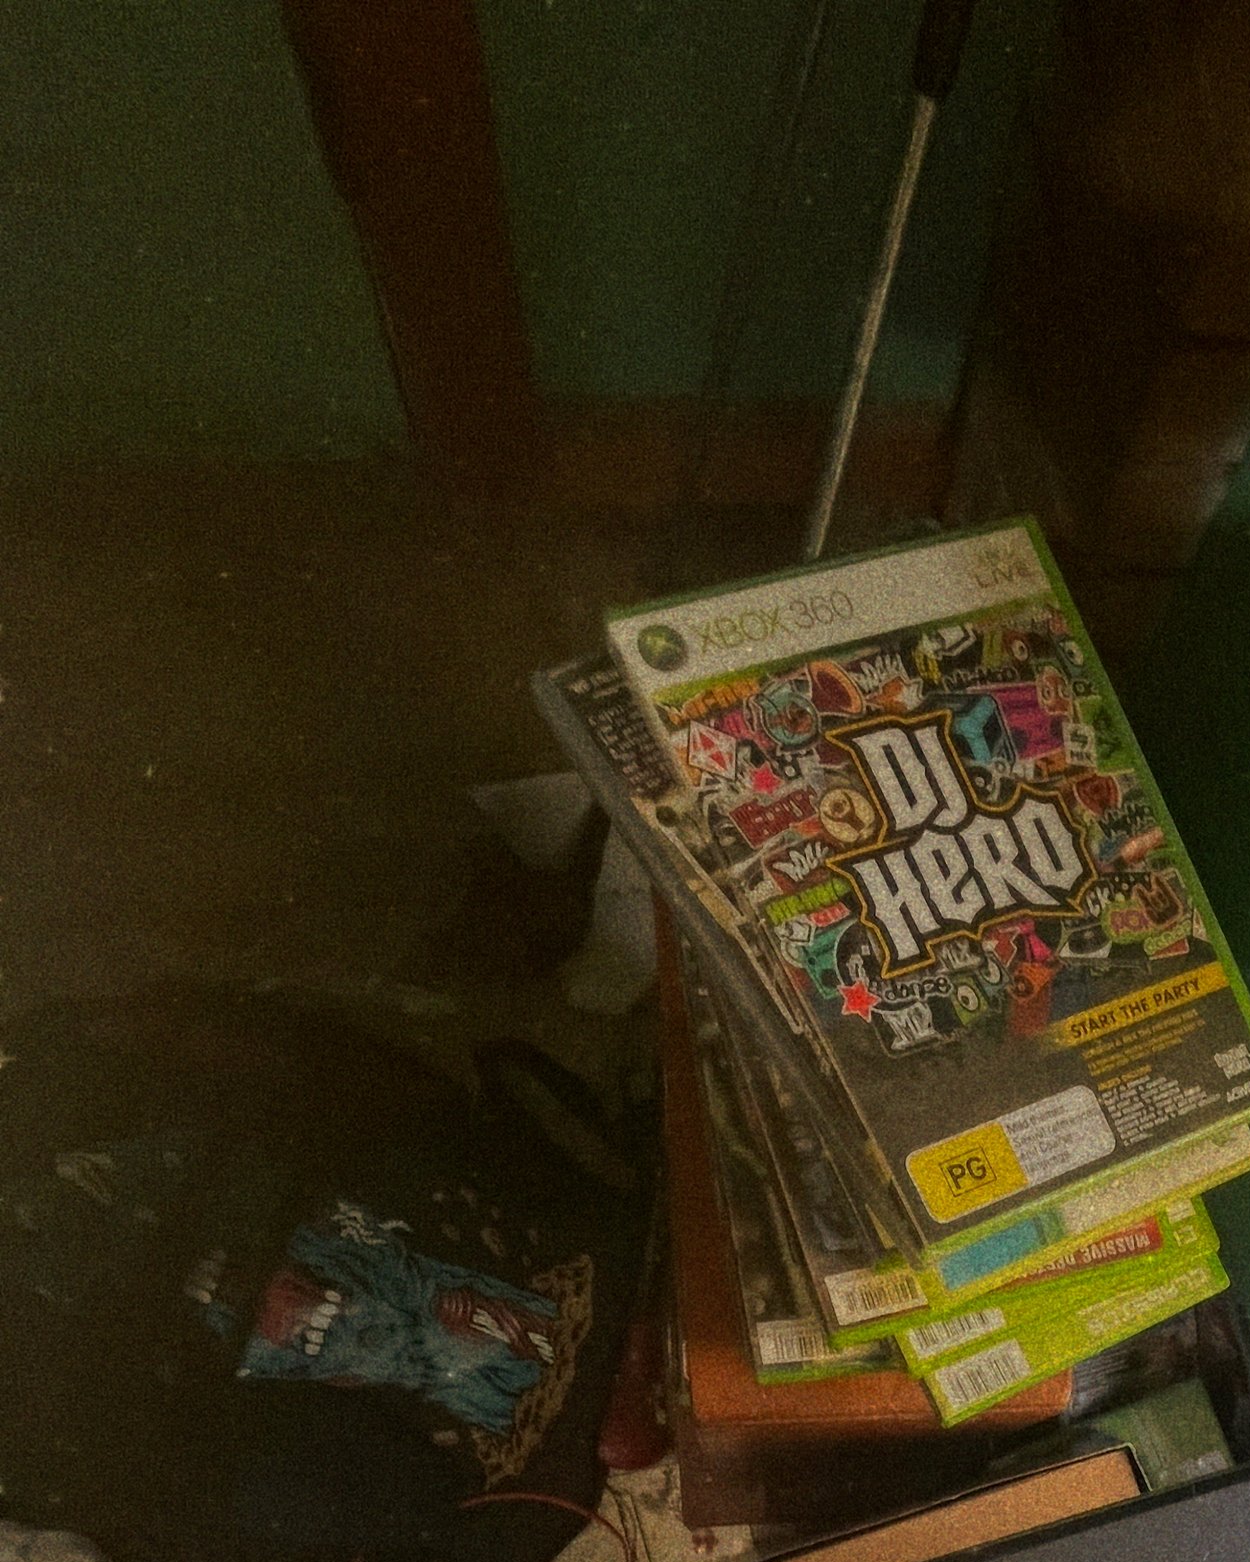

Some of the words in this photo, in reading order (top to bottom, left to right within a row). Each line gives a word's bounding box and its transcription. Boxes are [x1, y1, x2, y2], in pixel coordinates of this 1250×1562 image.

[692, 604, 788, 652] XBOX
[790, 589, 853, 629] 360
[852, 725, 968, 831] DJ
[1071, 1012, 1117, 1039] START
[1120, 997, 1149, 1019] THE
[1153, 978, 1201, 1008] PARTY
[946, 1156, 987, 1190] PG
[1080, 1233, 1151, 1264] MASSIVE
